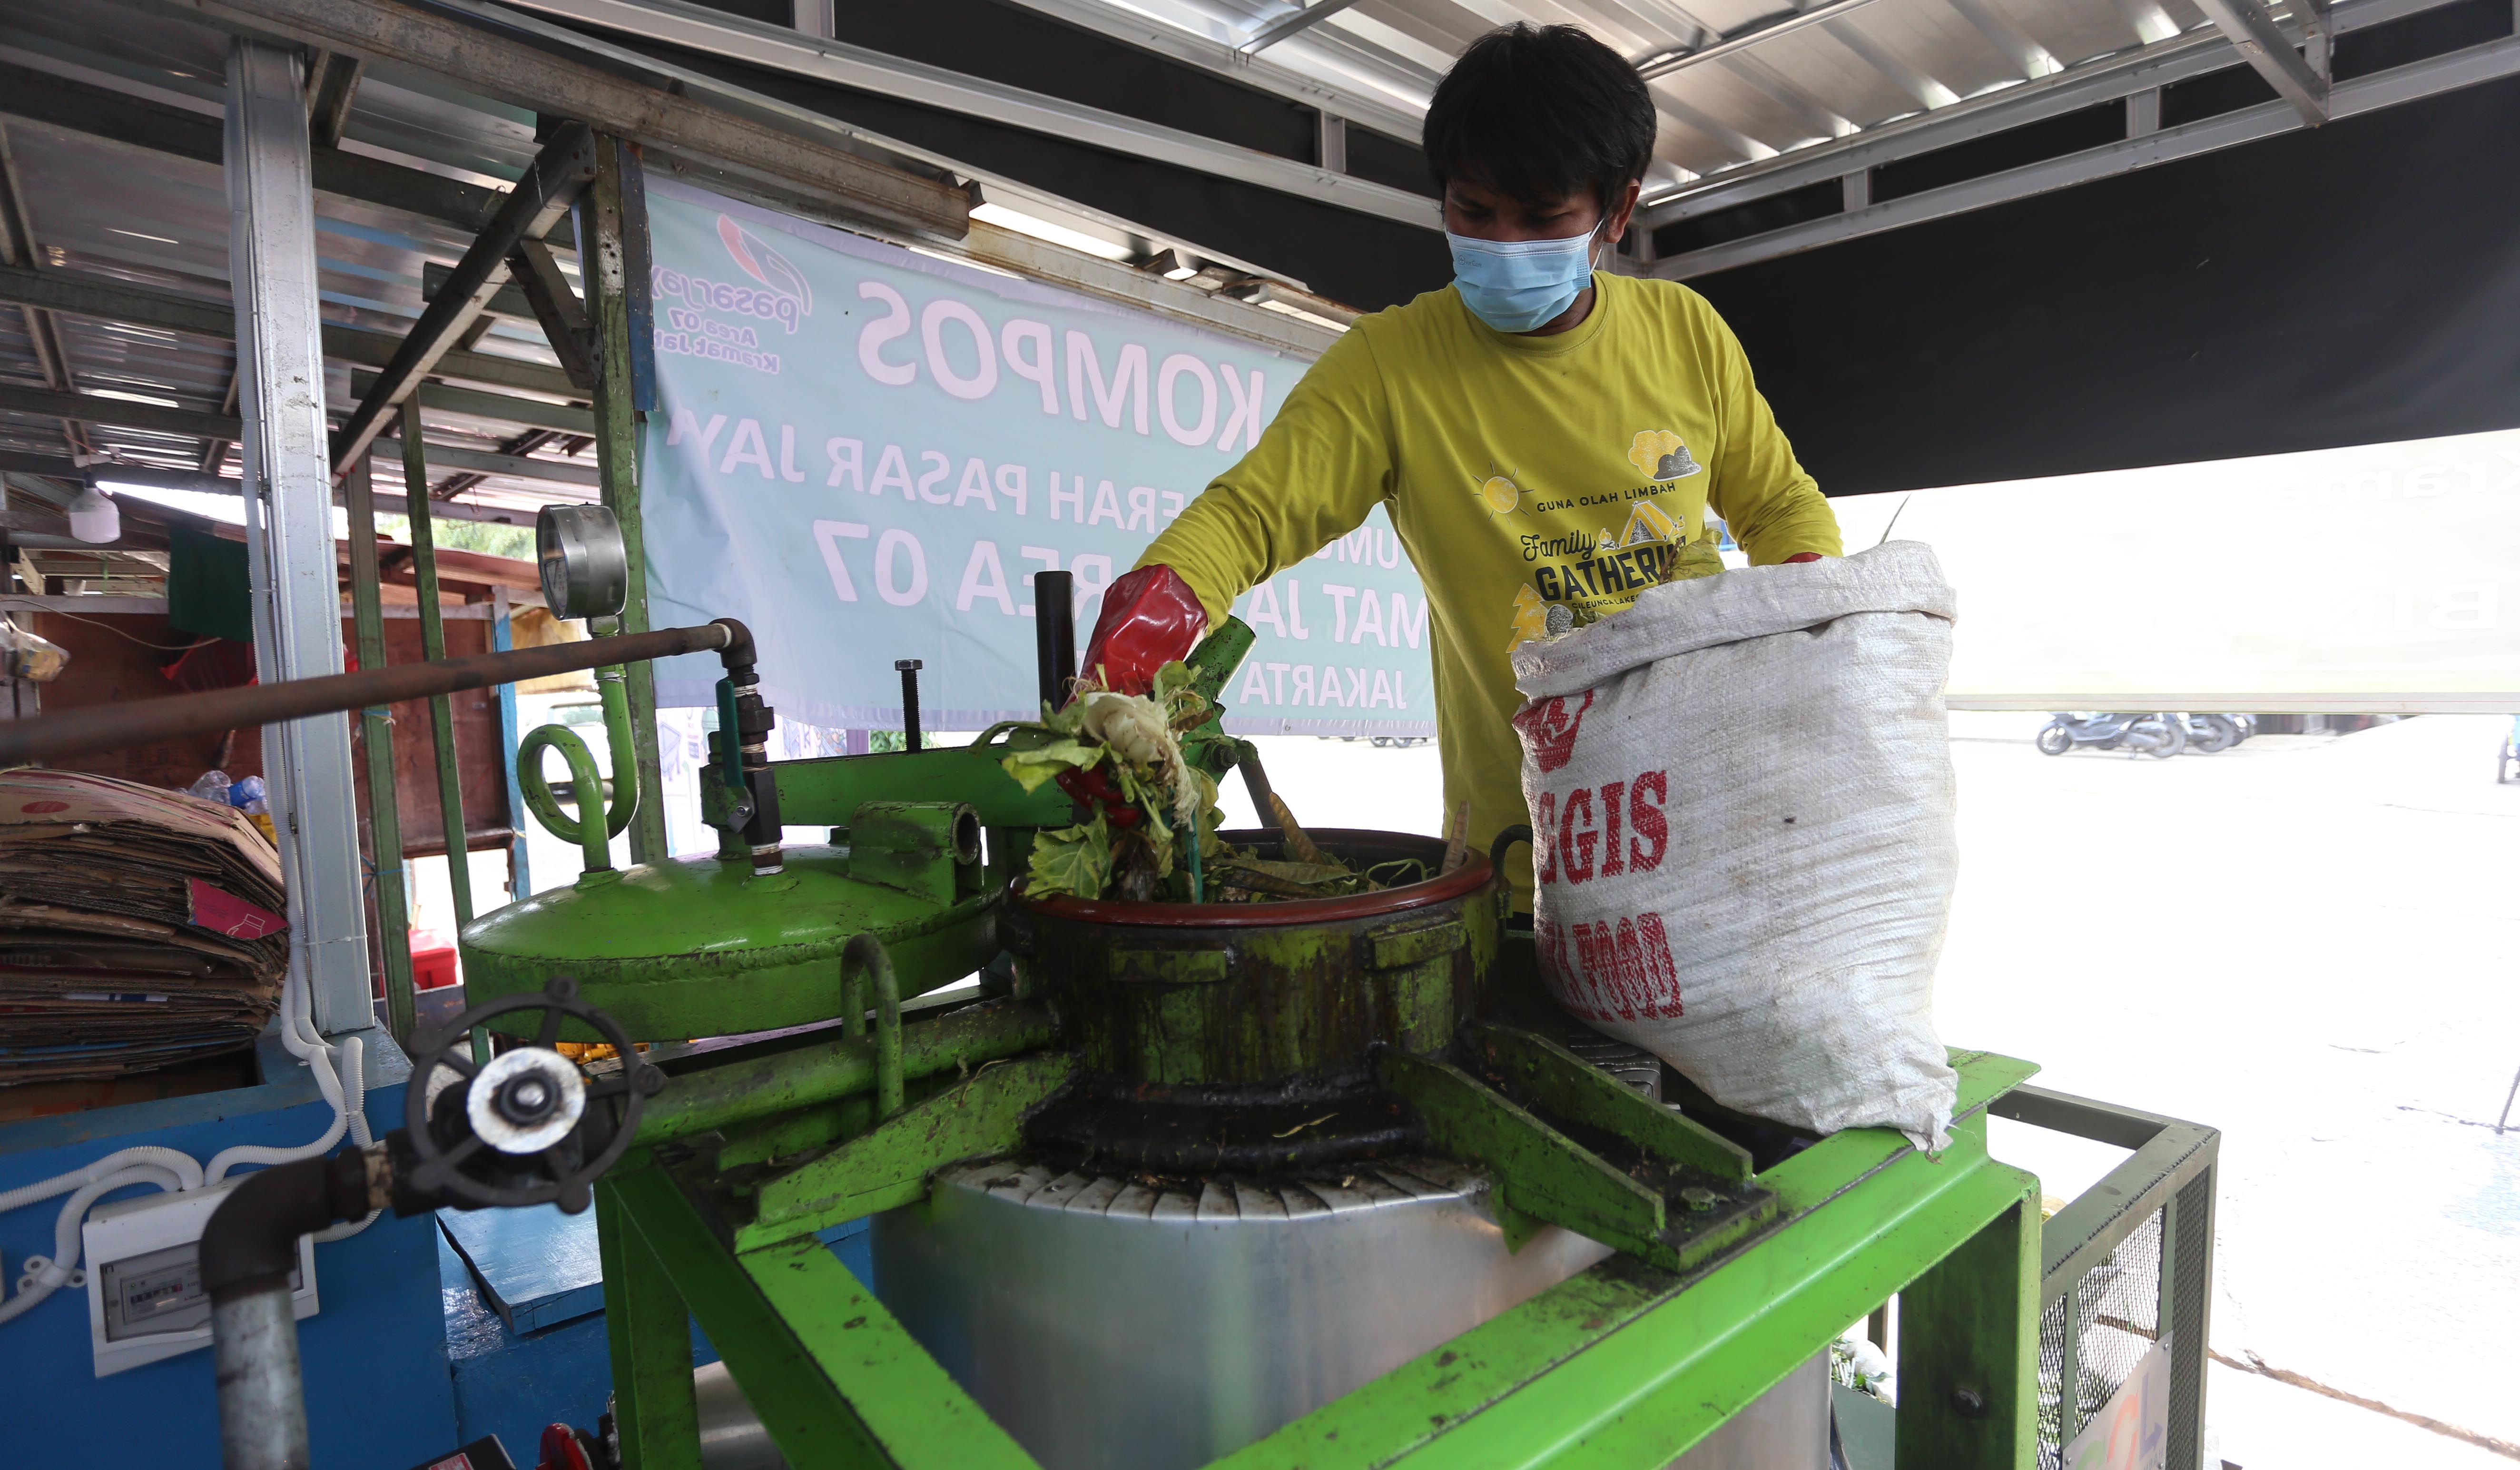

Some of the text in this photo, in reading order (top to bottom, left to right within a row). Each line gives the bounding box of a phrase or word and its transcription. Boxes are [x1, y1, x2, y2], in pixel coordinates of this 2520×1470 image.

[1537, 482, 1676, 513] GUNA OLAH LIMBAH
[1520, 529, 1596, 562] Family
